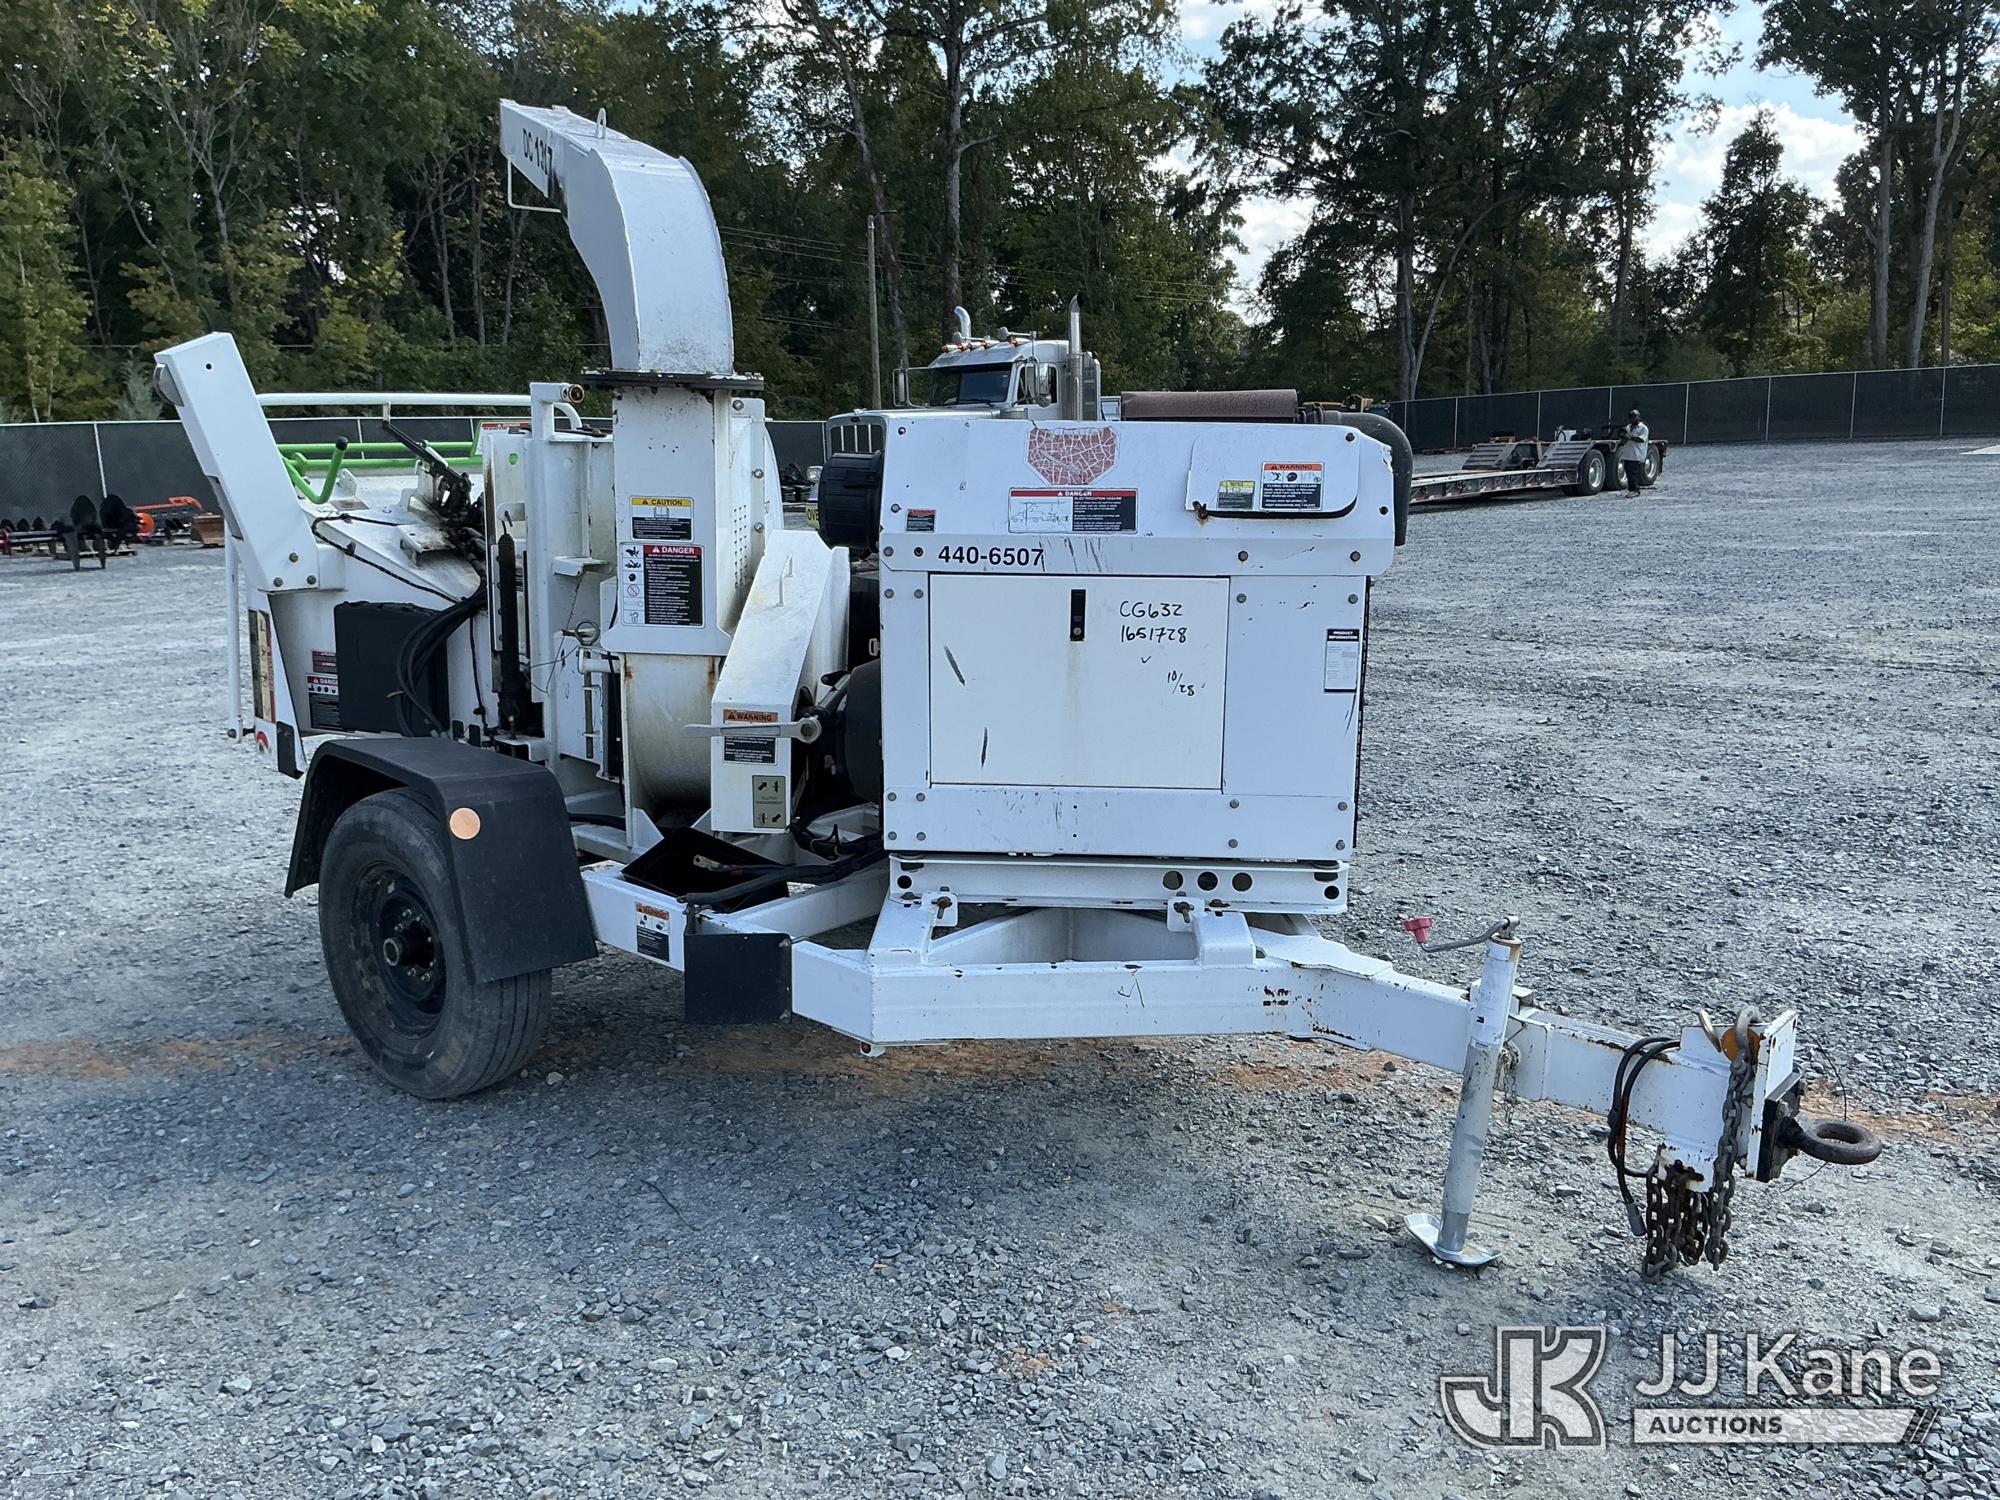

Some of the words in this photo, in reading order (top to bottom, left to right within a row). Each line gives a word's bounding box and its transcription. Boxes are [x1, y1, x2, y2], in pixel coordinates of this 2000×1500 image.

[651, 499, 683, 507] CAUTION
[661, 546, 695, 555] DANGER
[938, 545, 1045, 567] 440-6507
[1121, 624, 1188, 644] 1651728
[736, 712, 772, 722] WARNING
